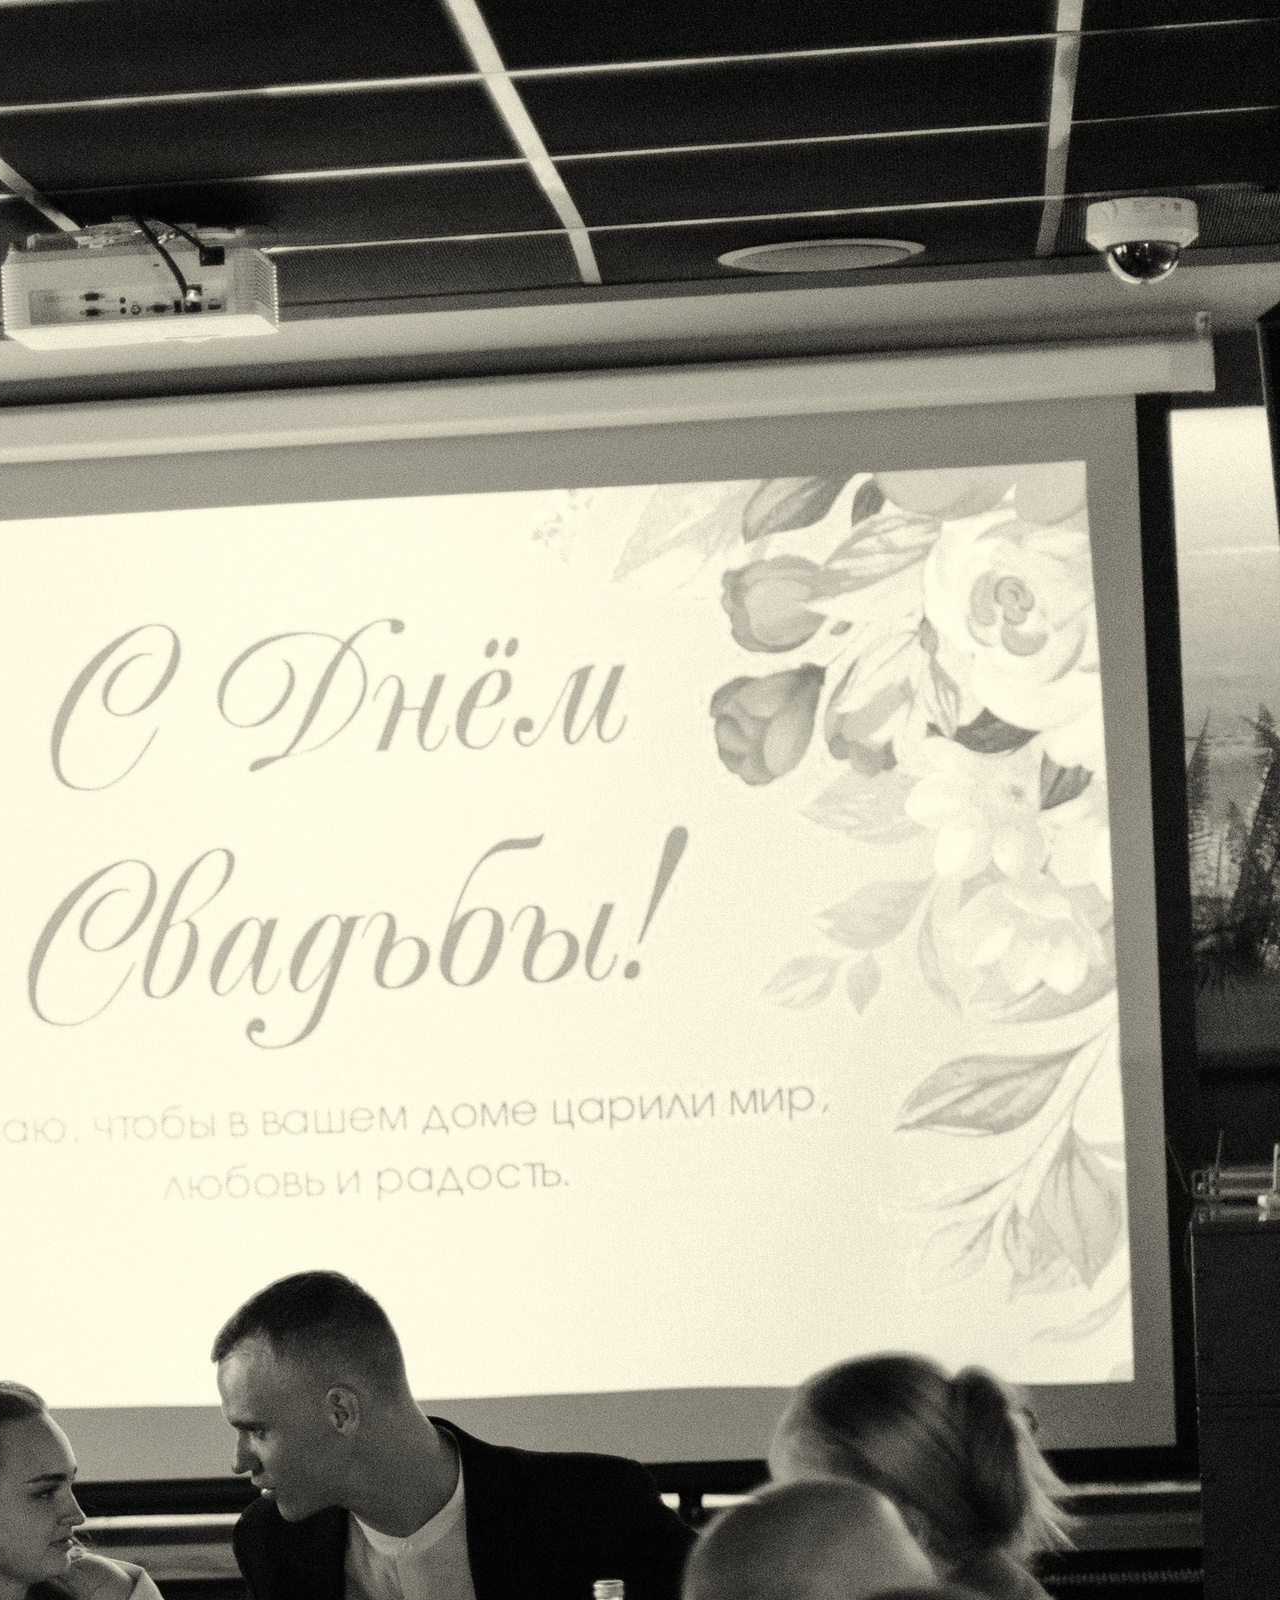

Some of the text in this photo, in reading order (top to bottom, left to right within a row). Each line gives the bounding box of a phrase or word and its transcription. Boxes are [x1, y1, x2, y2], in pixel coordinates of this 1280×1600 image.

[49, 617, 628, 792] С Днём
[26, 825, 690, 1050] Свадьбы!
[93, 1105, 217, 1142] чтобы
[228, 1110, 250, 1139] в
[261, 1104, 409, 1137] вашем
[421, 1099, 538, 1135] доме
[552, 1092, 716, 1131] царили
[729, 1085, 830, 1121] мир,
[163, 1161, 570, 1203] любовь и радость.
